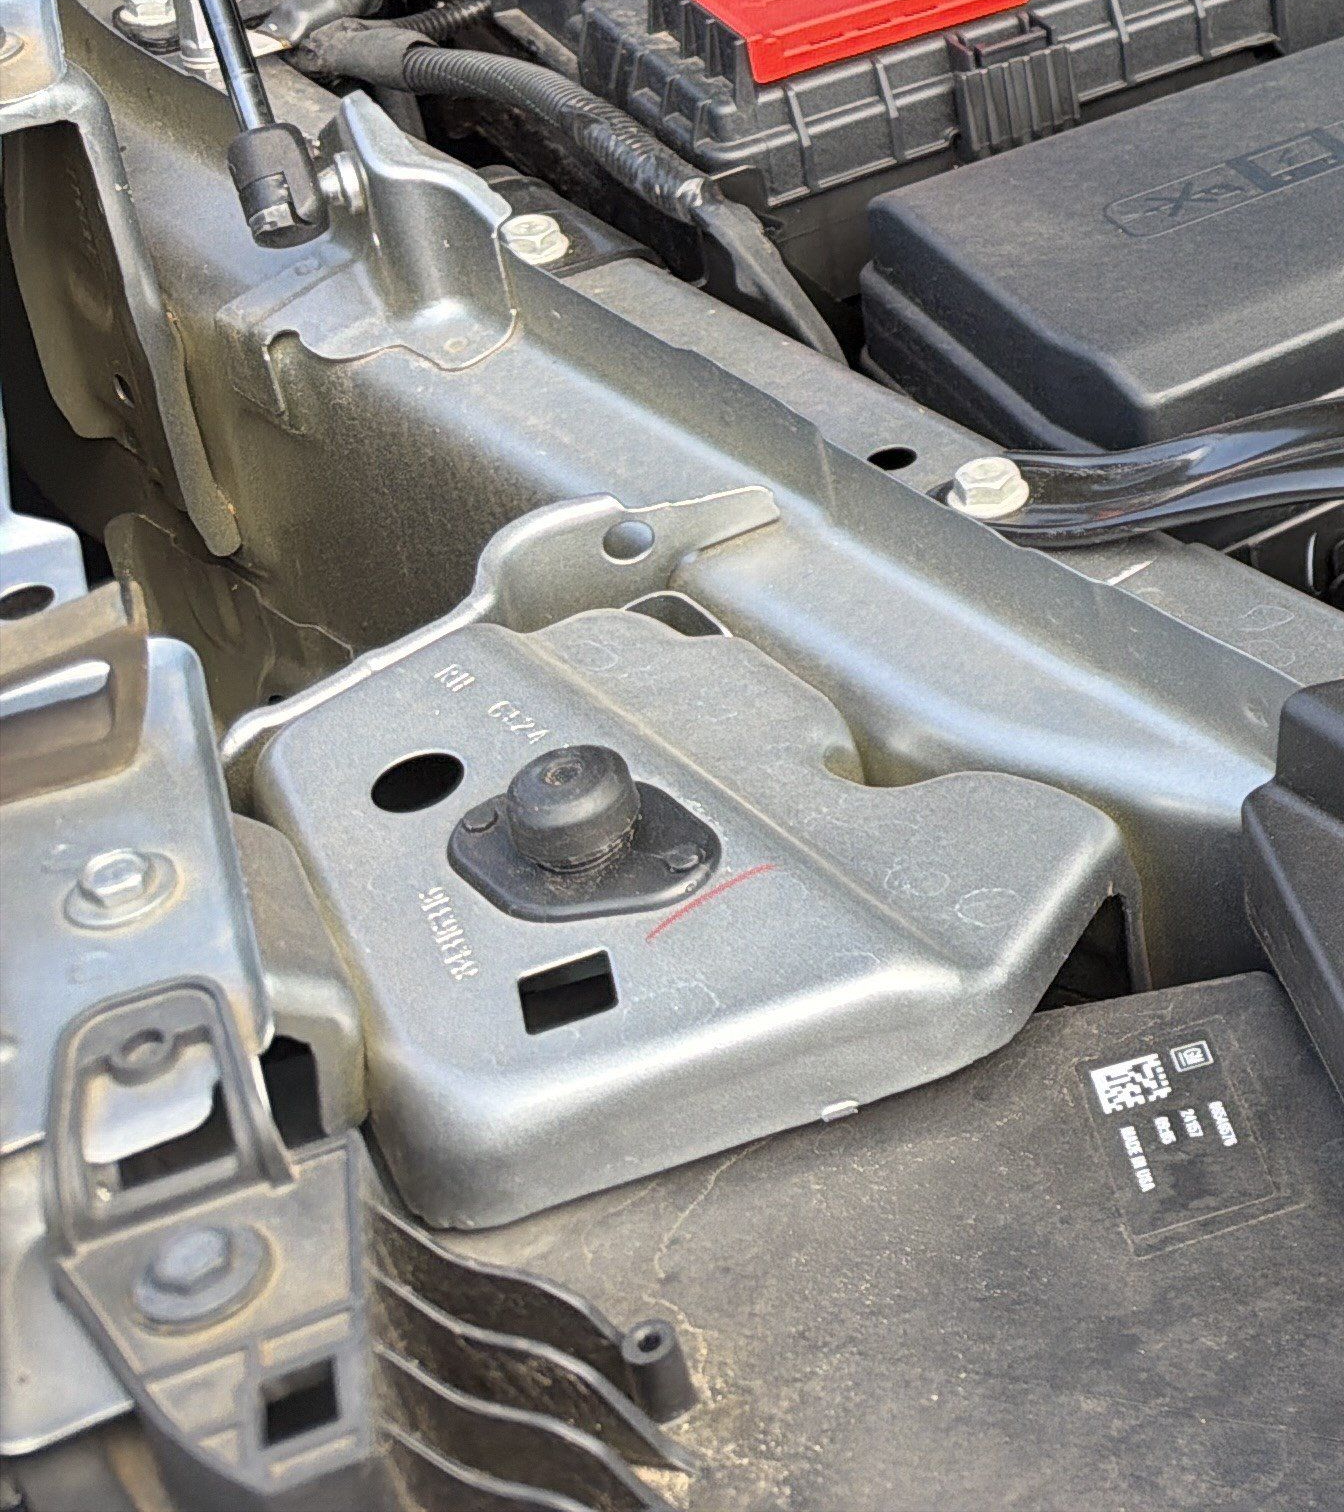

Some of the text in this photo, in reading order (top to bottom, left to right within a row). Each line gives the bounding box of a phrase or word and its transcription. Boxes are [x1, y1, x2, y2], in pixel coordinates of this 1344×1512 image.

[1118, 1125, 1156, 1193] MADE IN USA
